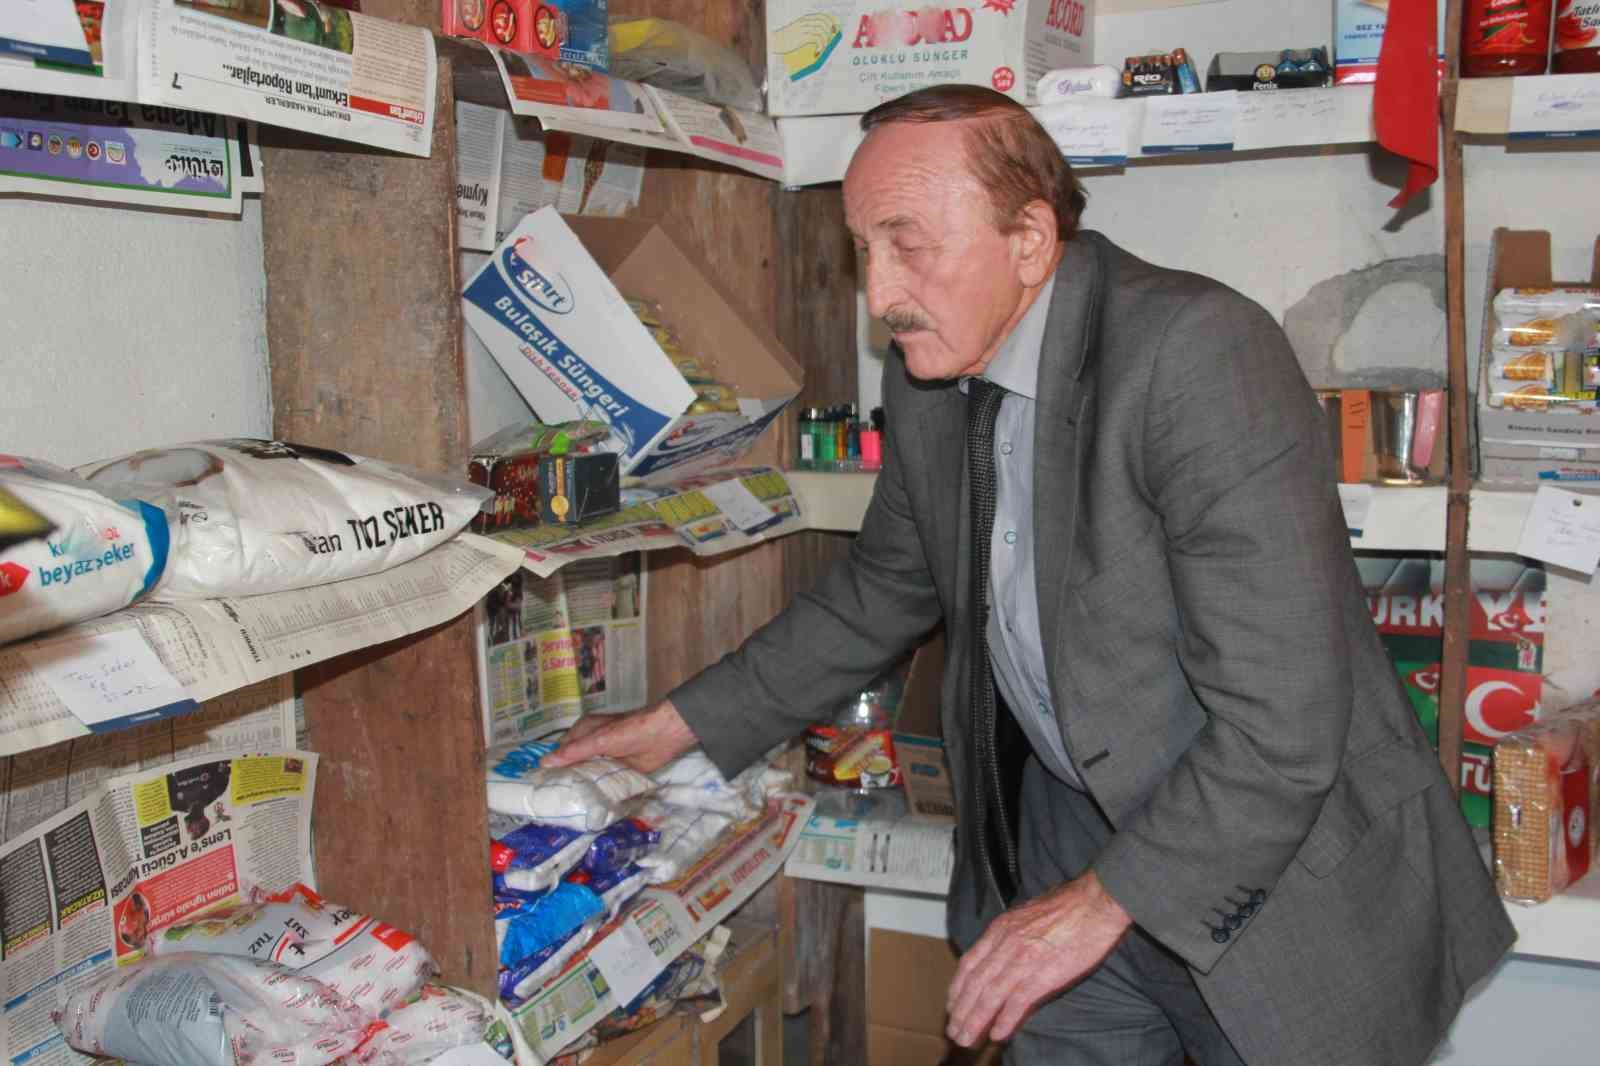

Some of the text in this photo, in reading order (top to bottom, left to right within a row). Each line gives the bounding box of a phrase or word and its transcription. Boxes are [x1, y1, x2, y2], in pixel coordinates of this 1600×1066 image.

[171, 72, 183, 90] 7
[494, 295, 631, 420] Bulaşık Süngeri
